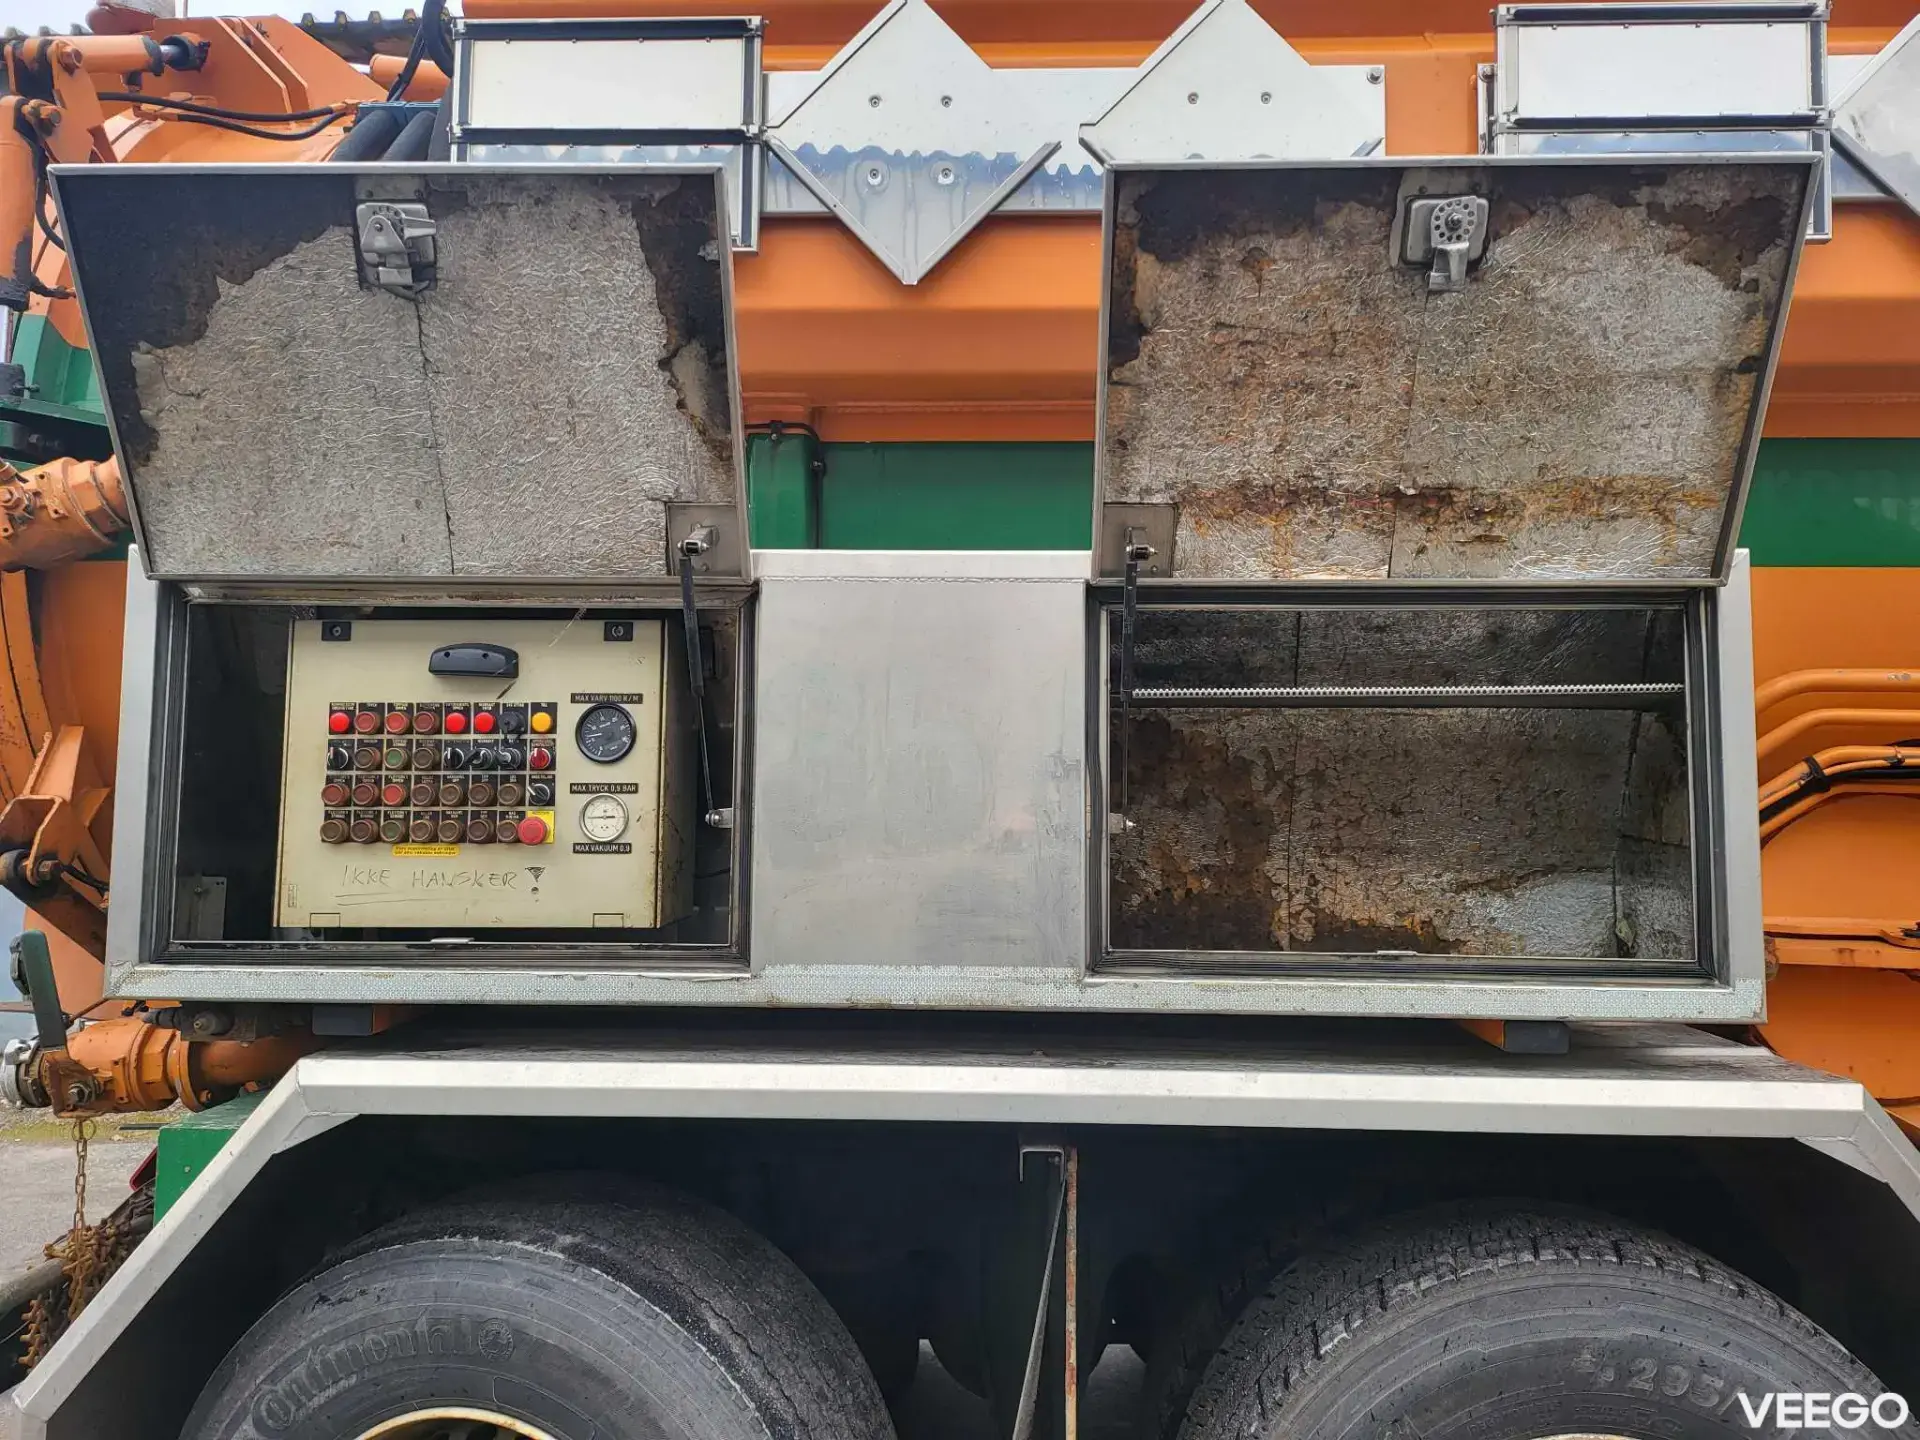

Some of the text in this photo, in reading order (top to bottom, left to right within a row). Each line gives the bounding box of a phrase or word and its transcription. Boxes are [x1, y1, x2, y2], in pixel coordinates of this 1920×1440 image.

[571, 784, 587, 792] MAX
[587, 784, 609, 792] TRYCK
[622, 784, 637, 792] BAR
[575, 844, 590, 852] MAX
[590, 844, 619, 852] VAKUUM
[342, 864, 391, 886] IKKE
